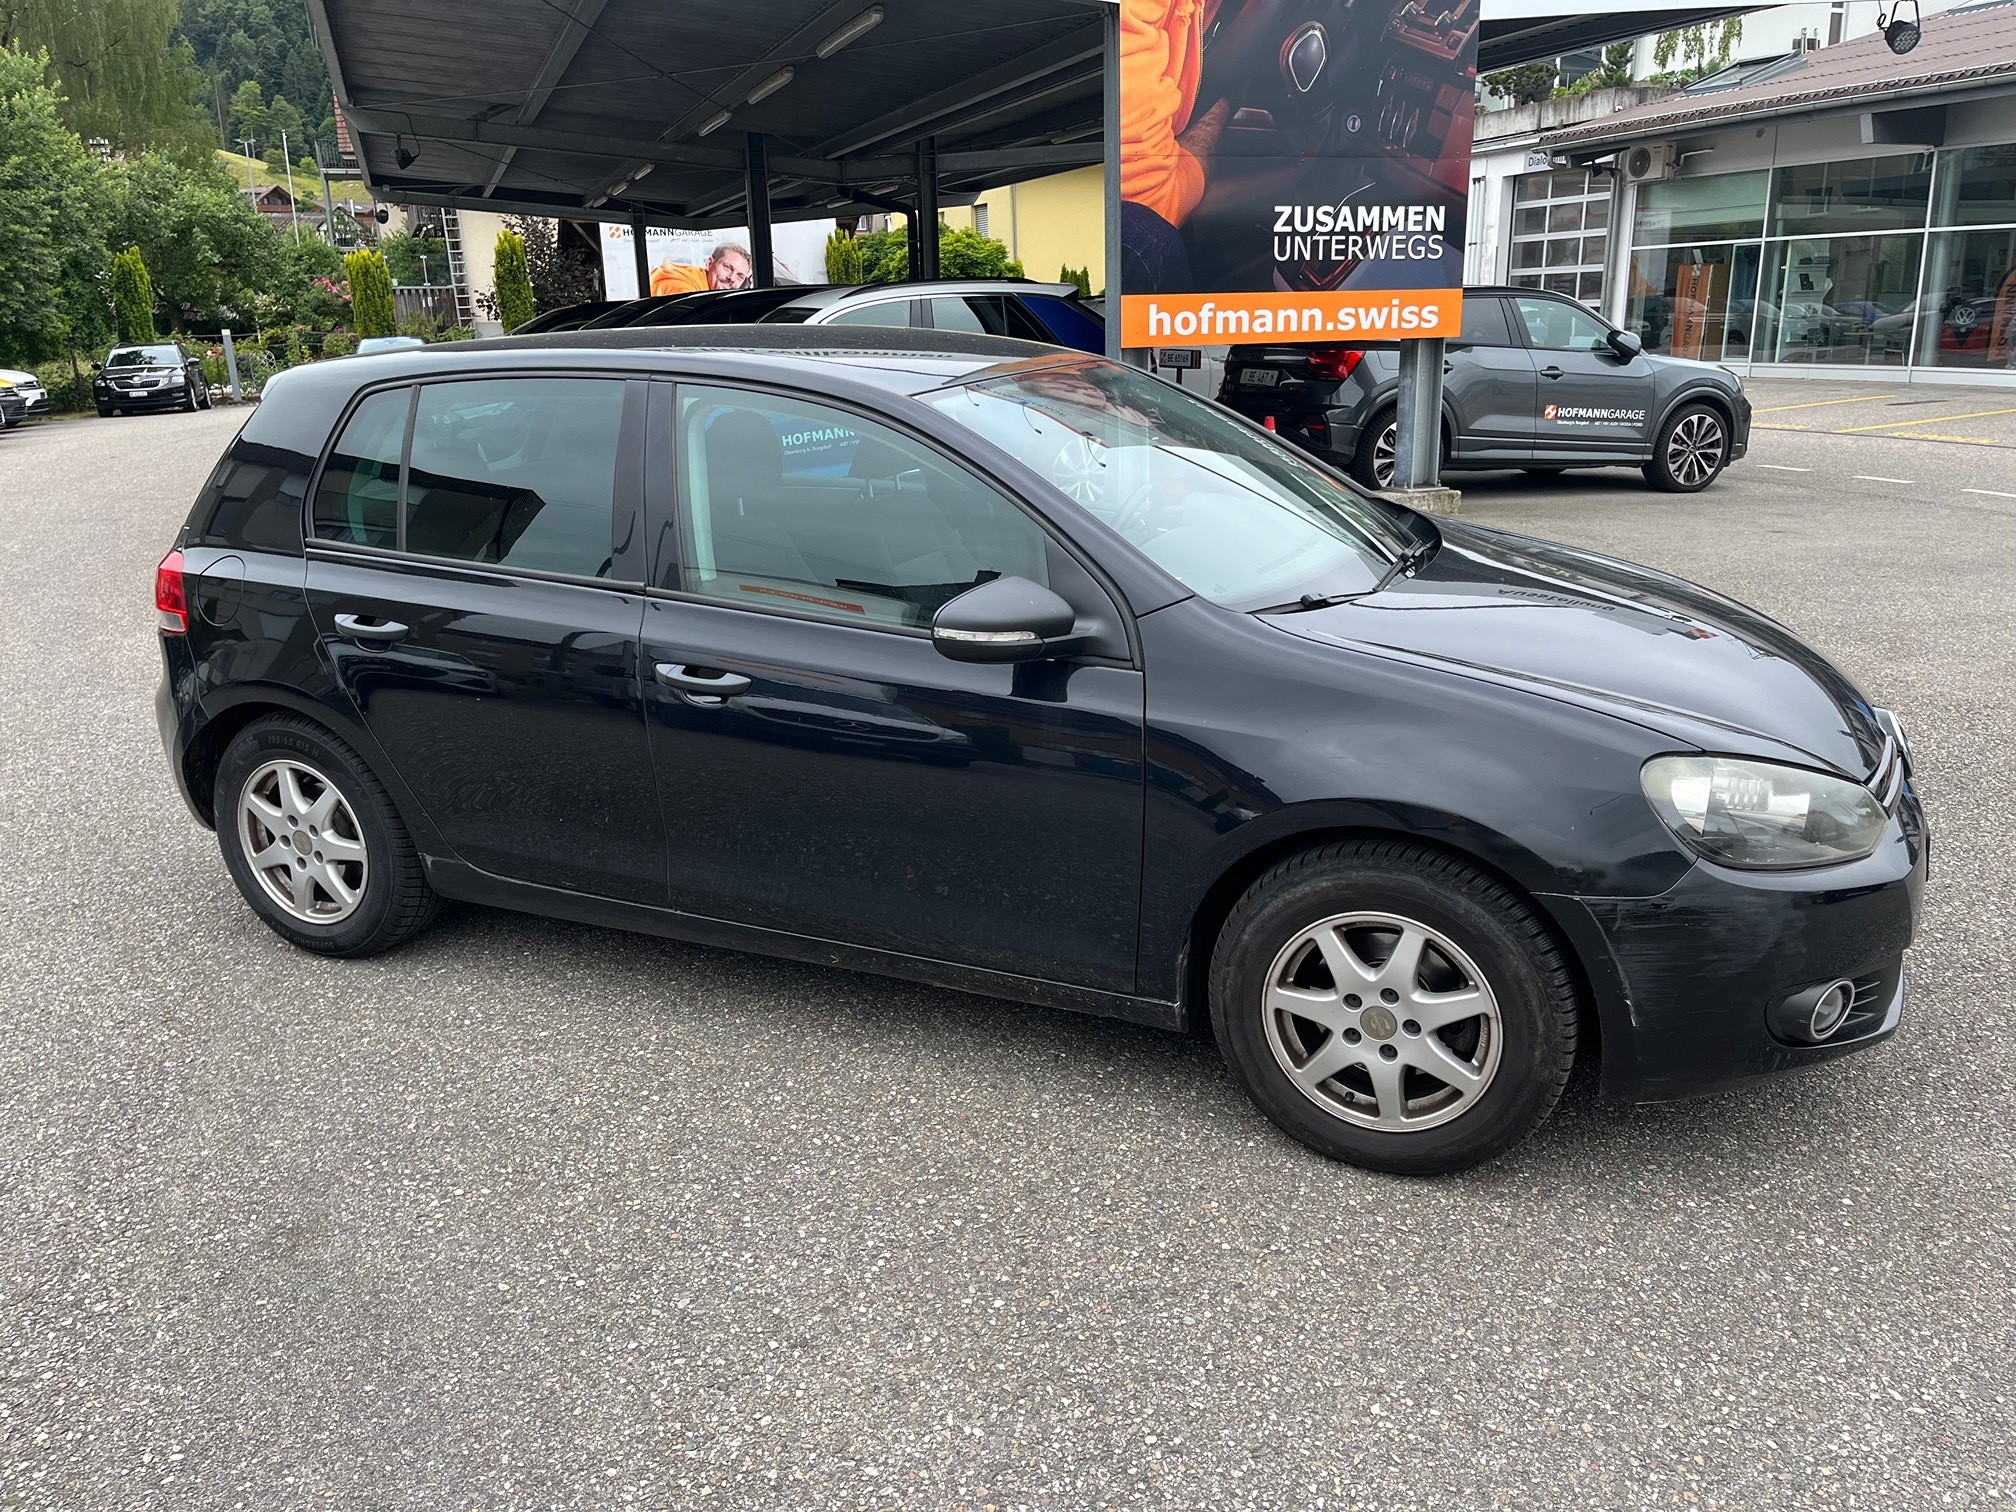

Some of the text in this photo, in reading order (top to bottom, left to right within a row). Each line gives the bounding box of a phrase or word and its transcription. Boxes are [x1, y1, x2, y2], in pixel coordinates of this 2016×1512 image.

[1273, 206, 1446, 233] ZUSAMMEN
[1273, 235, 1444, 262] UNTERWEGS
[1148, 298, 1440, 336] hofmann.swiss
[1557, 408, 1645, 420] HOFMANNGARAGE
[268, 735, 293, 746] 195/65
[296, 740, 310, 752] R15
